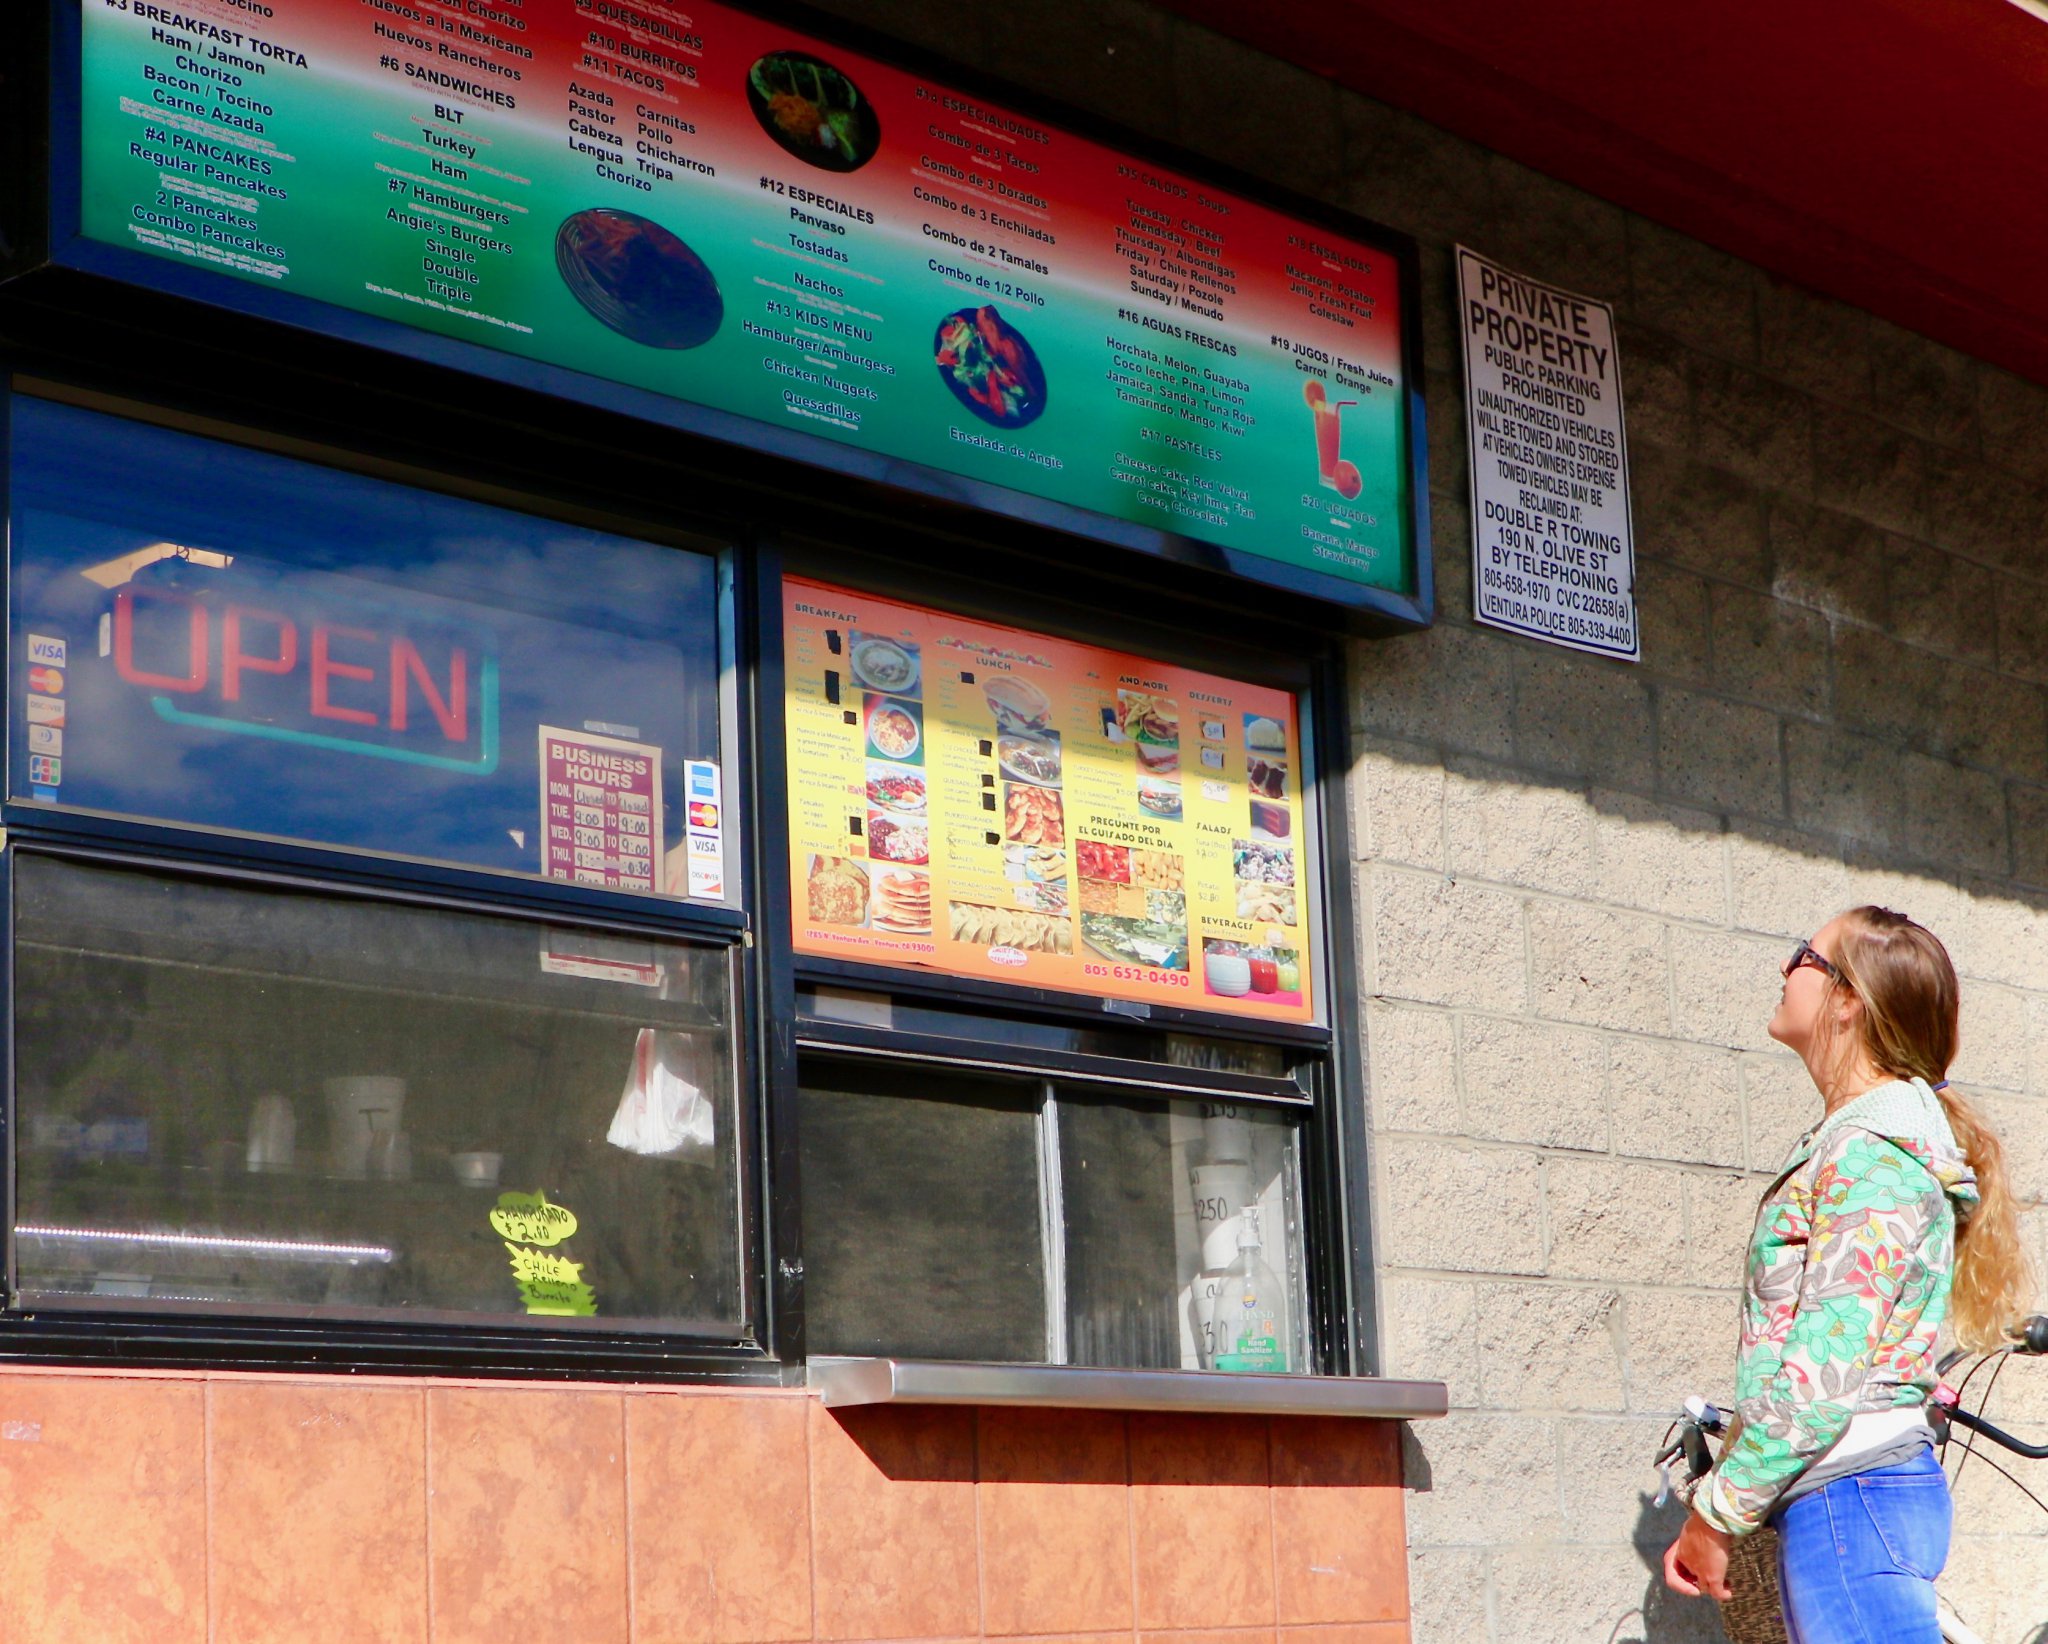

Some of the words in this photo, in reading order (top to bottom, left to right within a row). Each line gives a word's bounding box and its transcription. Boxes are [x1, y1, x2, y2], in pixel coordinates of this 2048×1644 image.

[134, 1, 243, 47] BREAKFAST
[249, 38, 308, 69] TORTA
[152, 27, 191, 51] Ham
[208, 46, 265, 74] Jamon
[374, 22, 433, 52] Huevos
[438, 40, 522, 81] Rancheros
[176, 56, 242, 87] Chorizo
[380, 55, 399, 71] #6
[405, 61, 516, 109] SANDWICHES
[583, 54, 608, 73] #11
[615, 65, 665, 92] TACOS
[144, 65, 199, 94] Bacon
[216, 87, 273, 116] Tocino
[568, 82, 614, 107] Azada
[153, 89, 205, 116] Carne
[211, 108, 264, 133] Azada
[434, 105, 464, 125] BLT
[569, 100, 615, 125] Pastor
[636, 105, 695, 134] Carnitas
[422, 129, 476, 159] Turkey
[568, 119, 623, 146] Cabeza
[638, 123, 673, 144] Pollo
[145, 128, 166, 144] #4
[173, 134, 272, 175] PANCAKES
[569, 137, 623, 165] Lengua
[636, 141, 715, 177] Chicharron
[130, 142, 198, 173] Regular
[205, 164, 287, 199] Pancakes
[431, 159, 467, 181] Ham
[596, 165, 652, 192] Chorizo
[636, 158, 673, 180] Tripa
[157, 191, 167, 205] 2
[173, 196, 257, 231] Pancakes
[388, 178, 407, 195] #7
[413, 185, 510, 225] Hamburgers
[760, 176, 785, 195] #12
[789, 186, 875, 225] ESPECIALES
[133, 205, 196, 233] Combo
[202, 227, 285, 258] Pancakes
[386, 208, 445, 236] Angie's
[451, 226, 513, 255] Burgers
[790, 207, 845, 235] Panvaso
[426, 239, 475, 264] Single
[789, 234, 848, 263] Tostadas
[923, 224, 966, 247] Combo
[970, 240, 984, 254] de
[988, 246, 995, 257] 2
[999, 249, 1049, 275] Tamales
[423, 258, 479, 284] Double
[794, 272, 844, 298] Nachos
[928, 259, 972, 282] Combo
[976, 275, 990, 288] de
[994, 281, 1011, 296] 1/2
[1016, 288, 1045, 307] Pollo
[426, 278, 472, 302] Triple
[1131, 281, 1171, 305] Sunday
[1181, 298, 1224, 321] Menudo
[1481, 266, 1591, 338] PRIVATE
[766, 300, 791, 318] #13
[795, 309, 828, 329] KIDS
[833, 316, 872, 342] MENU
[1118, 308, 1138, 323] #16
[1142, 317, 1181, 338] AGUAS
[1185, 330, 1237, 356] FRESCAS
[1470, 300, 1607, 380] PROPERTY
[1271, 335, 1289, 350] #19
[1292, 344, 1328, 364] JUGOS
[1337, 358, 1365, 377] Fresh
[1367, 370, 1393, 386] Juice
[1295, 359, 1327, 378] Carrot
[1336, 373, 1371, 394] Orange
[1485, 345, 1534, 378] PUBLIC
[1539, 365, 1600, 400] PARKING
[764, 358, 819, 384] Chicken
[824, 376, 878, 401] Nuggets
[1503, 373, 1585, 416] PROHIBITED
[783, 390, 861, 422] Quesadillas
[1478, 388, 1560, 432] UNAUTHORIZED
[1562, 418, 1615, 449] VEHICLES
[950, 427, 1006, 453] Ensalada
[1009, 445, 1025, 457] de
[1028, 450, 1062, 468] Angie
[1477, 409, 1500, 433] WILL
[1503, 420, 1516, 438] BE
[1517, 424, 1553, 448] TOWED
[1556, 437, 1575, 457] AND
[1579, 444, 1618, 469] STORED
[1483, 433, 1492, 451] AT
[1494, 436, 1535, 466] VEHICLES
[1536, 450, 1574, 478] OWNER'S
[1577, 463, 1616, 490] EXPENSE
[1498, 459, 1527, 485] TOWED
[1529, 471, 1569, 498] VEHICLES
[1571, 483, 1588, 502] MAY
[1591, 490, 1602, 507] BE
[1520, 490, 1568, 519] RECLAIMED
[1570, 507, 1583, 524] AT:
[1485, 500, 1543, 534] DOUBLE
[1548, 520, 1557, 538] R
[1562, 524, 1621, 554] TOWING
[1499, 527, 1520, 548] 190
[1525, 535, 1539, 555] N.
[1543, 541, 1585, 567] OLIVE
[1590, 554, 1608, 571] ST
[1492, 546, 1510, 567] BY
[1514, 553, 1618, 595] TELEPHONING
[795, 603, 858, 623] BREAKFAST
[1485, 568, 1550, 602] 805-658-1970
[1557, 589, 1580, 611] CVC
[1583, 595, 1629, 623] 22658(a)
[1485, 594, 1528, 621] VENTURA
[1531, 607, 1565, 631] POLICE
[1568, 616, 1631, 645] 805-339-4400
[33, 643, 63, 659] VISA
[115, 586, 467, 743] OPEN
[975, 657, 1011, 670] LUNCH
[1119, 675, 1140, 685] AND
[1143, 680, 1168, 691] MORE
[1189, 691, 1232, 706] DESSERTS
[552, 744, 647, 775] BUSINESS
[566, 764, 632, 789] HOURS
[550, 782, 571, 797] MON.
[606, 792, 616, 805] TO
[551, 803, 570, 819] TUE.
[576, 811, 599, 825] 9:00
[606, 814, 616, 827] TO
[622, 817, 645, 832] 9:00
[1090, 816, 1140, 832] PREGUNTE
[1142, 824, 1161, 835] POR
[1196, 822, 1231, 834] SALADS
[551, 825, 571, 840] WED.
[576, 830, 600, 848] 9:00
[607, 835, 616, 848] TO
[622, 838, 648, 855] 9:00
[552, 846, 571, 861] THU.
[695, 840, 716, 852] VISA
[1078, 826, 1090, 834] EL
[1091, 828, 1135, 843] GUISADO
[1138, 835, 1155, 845] DEL
[1157, 839, 1173, 849] DIA
[1201, 916, 1253, 930] BEVERAGES
[1084, 963, 1108, 976] 805
[1113, 966, 1189, 987] 652-0490
